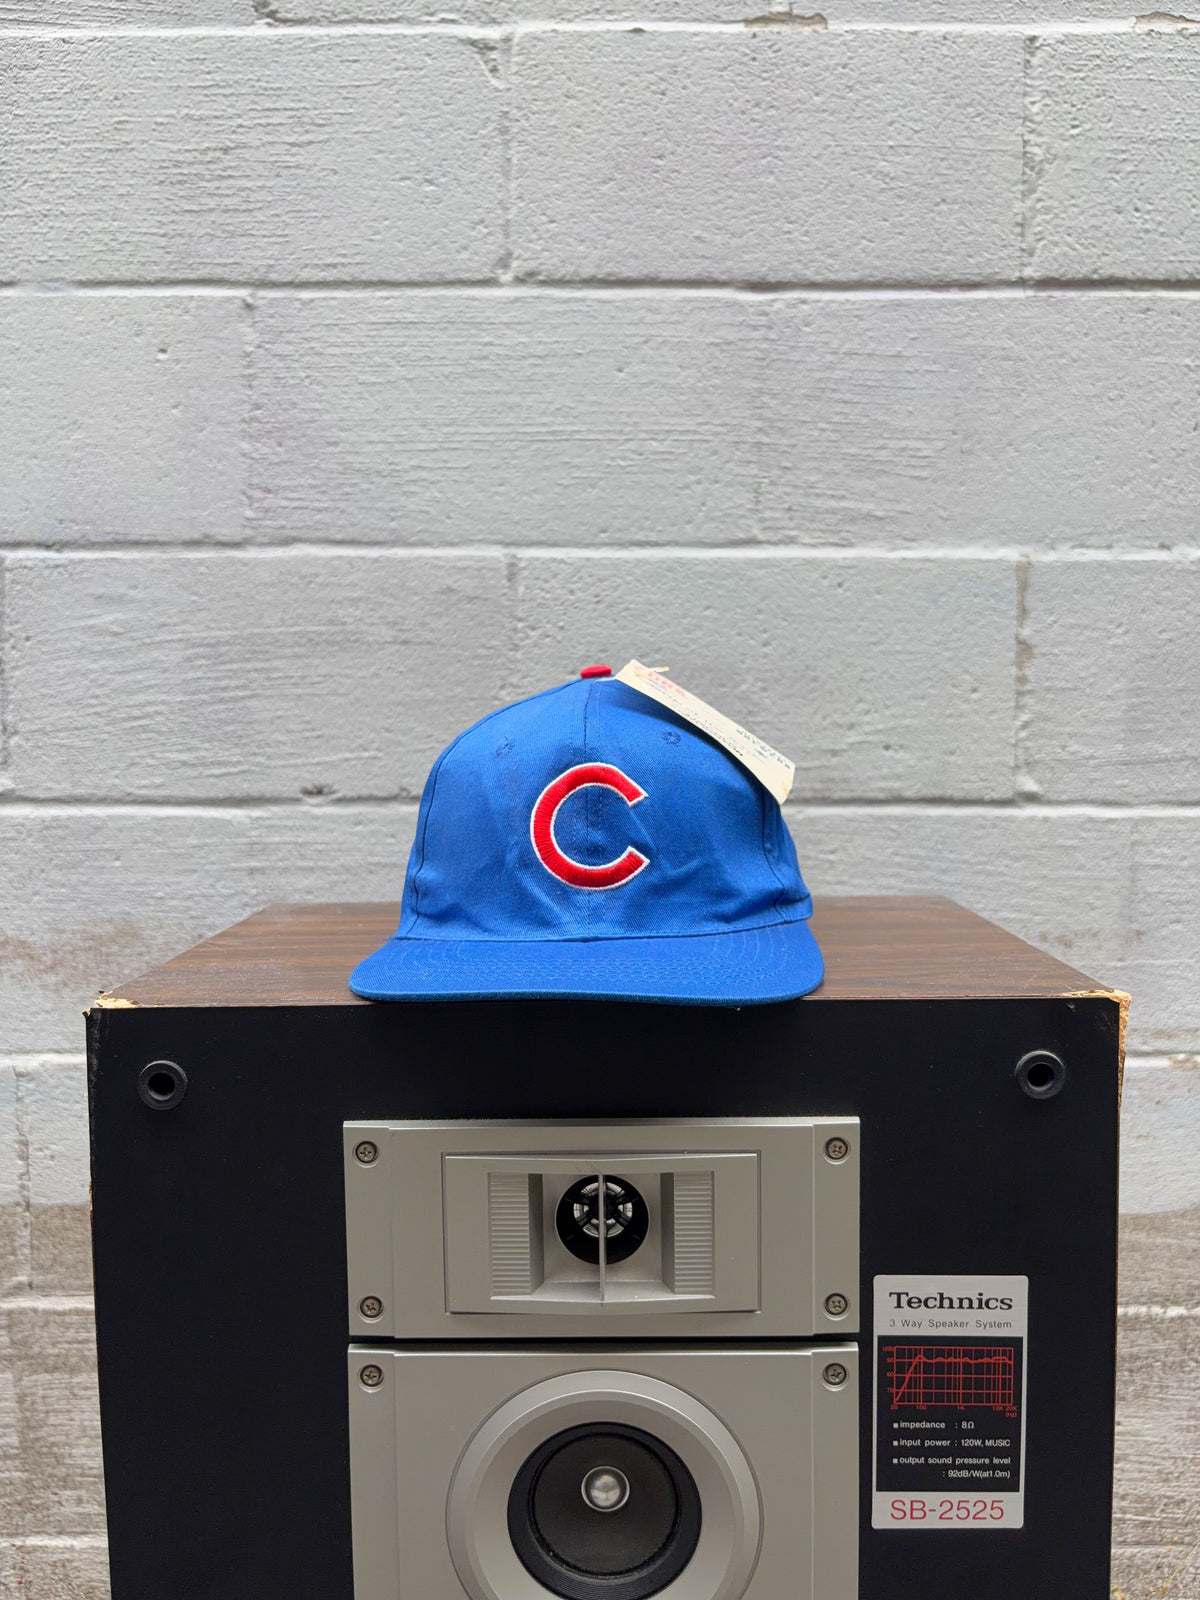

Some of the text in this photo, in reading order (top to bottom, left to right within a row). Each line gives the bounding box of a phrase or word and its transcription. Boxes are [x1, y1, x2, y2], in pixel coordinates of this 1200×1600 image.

[530, 762, 650, 890] C
[889, 1292, 1013, 1310] Technics
[889, 1319, 1012, 1329] 3 Way Speaker System
[900, 1421, 945, 1429] impedance
[900, 1439, 920, 1447] input
[890, 1500, 1004, 1520] SB-2525
